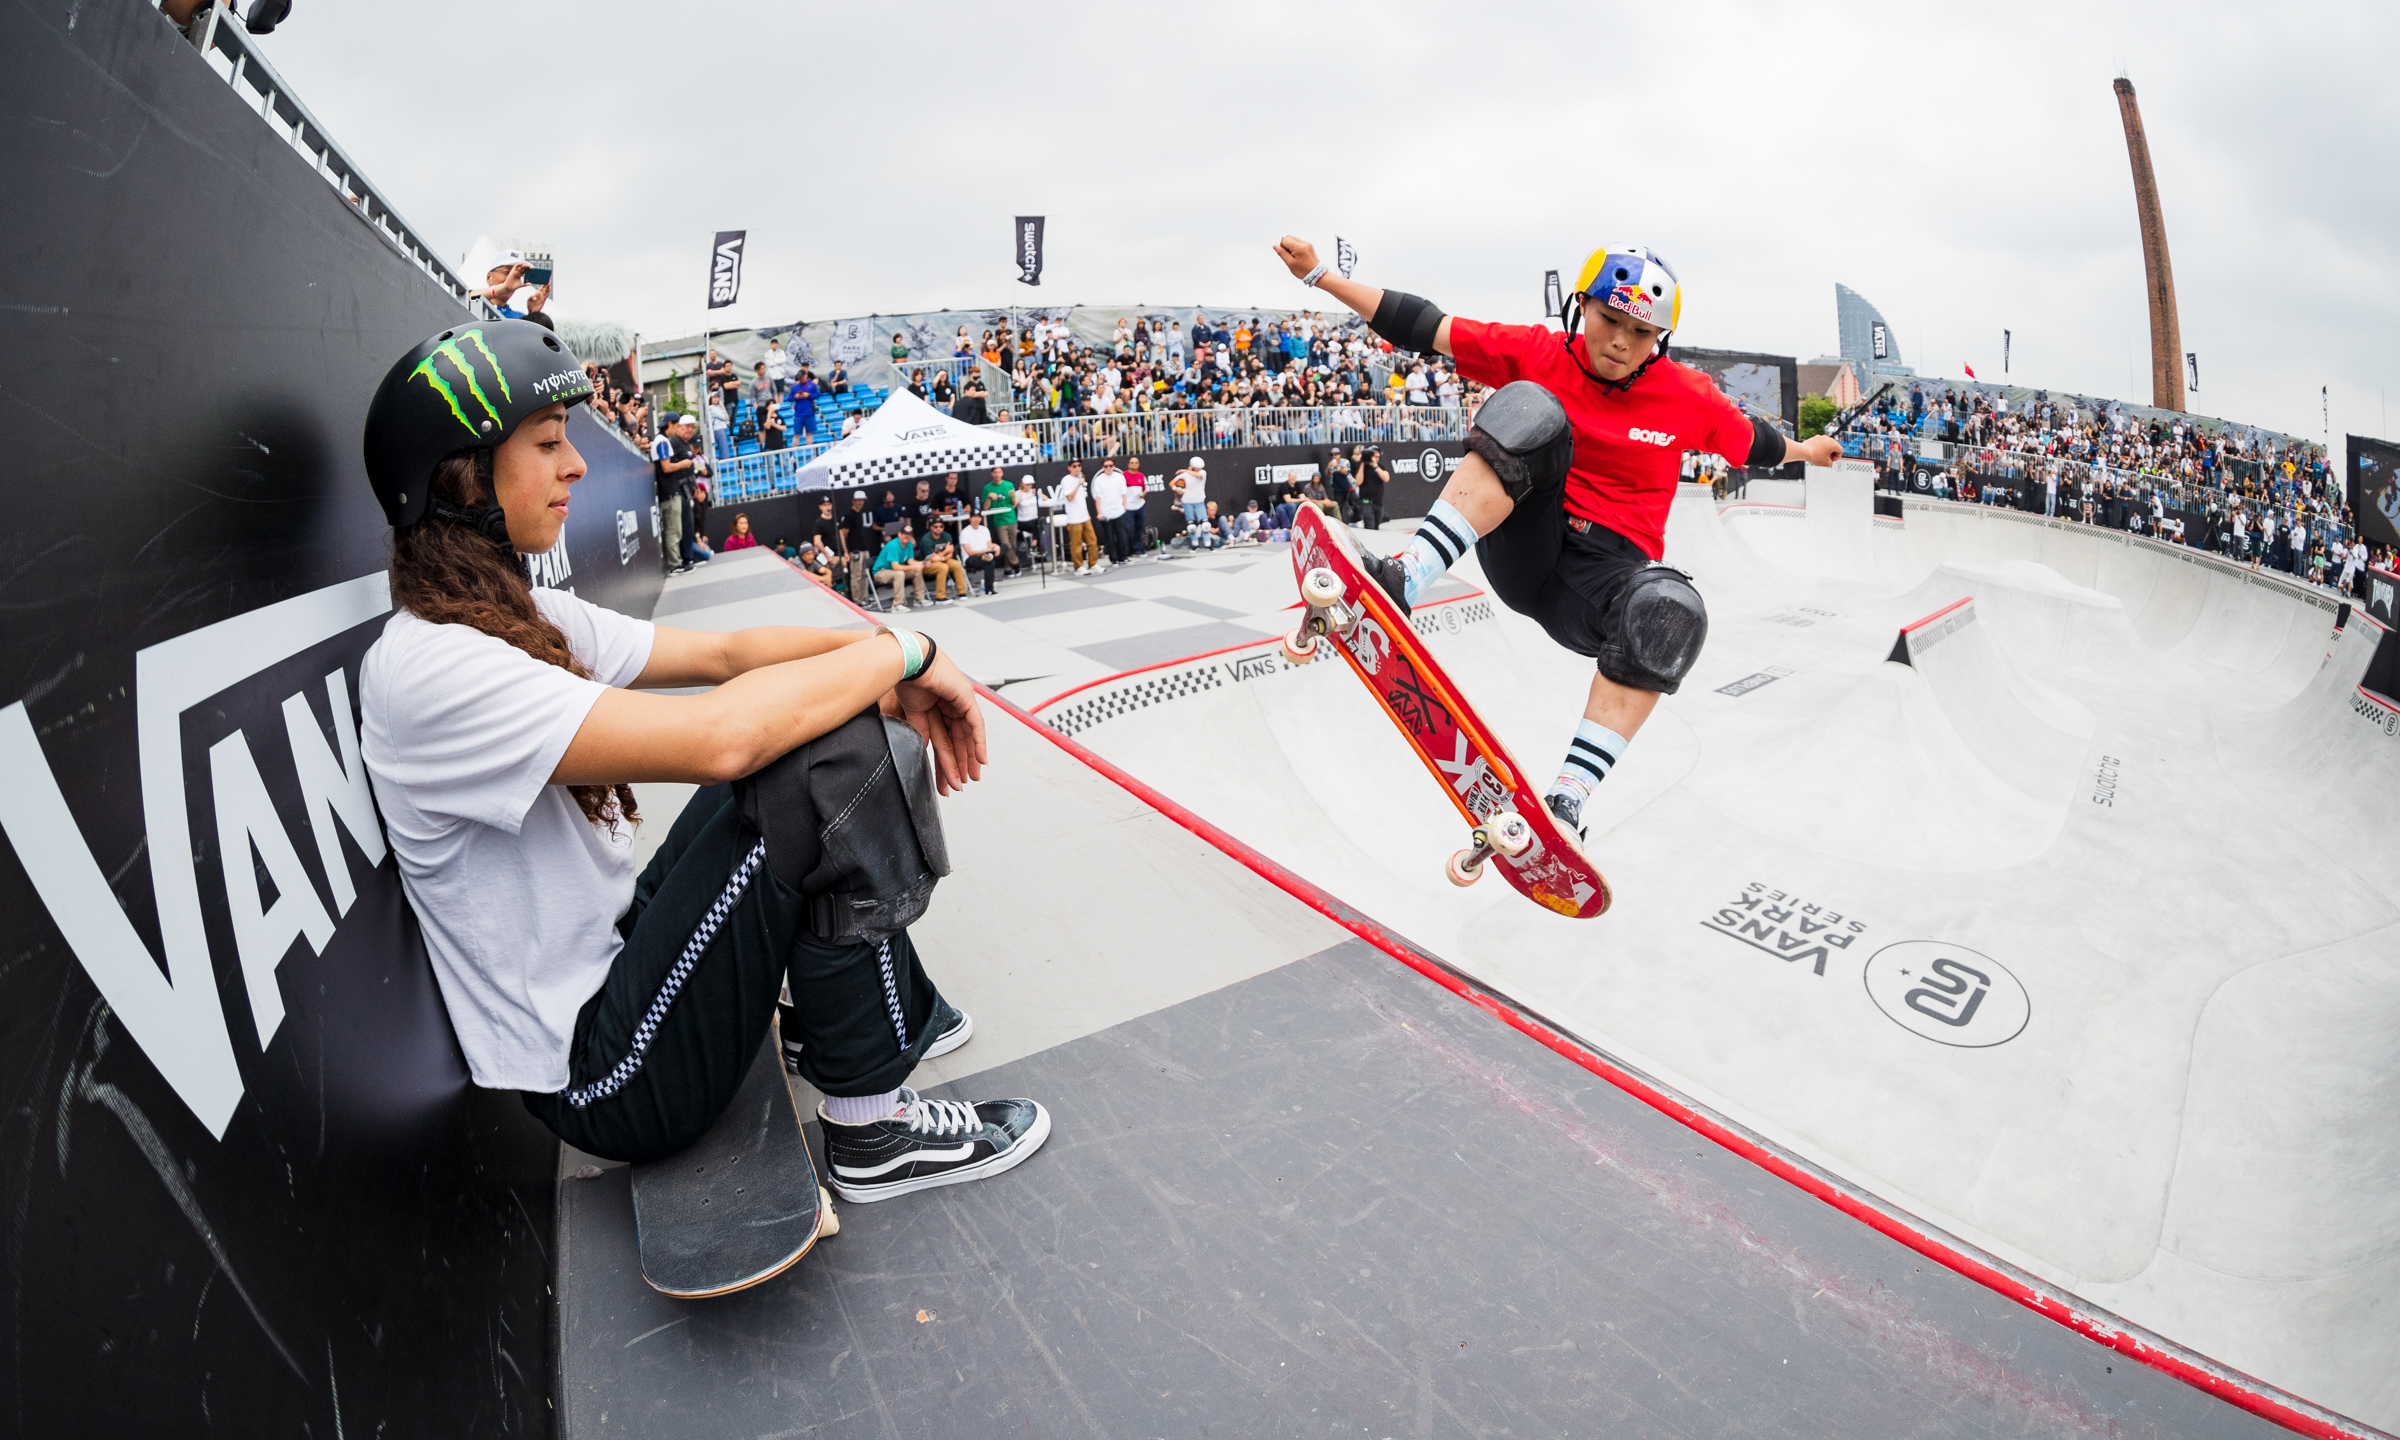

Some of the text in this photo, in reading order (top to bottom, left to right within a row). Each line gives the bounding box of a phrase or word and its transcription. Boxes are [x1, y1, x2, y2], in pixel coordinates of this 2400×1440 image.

[712, 238, 743, 303] VANS
[1608, 294, 1652, 321] Red Bull
[1873, 326, 1887, 357] VANS
[894, 424, 947, 441] VANS
[1628, 427, 1676, 447] BONES
[1391, 459, 1418, 474] VANS
[1444, 457, 1464, 465] PAR
[1145, 474, 1164, 484] ARK
[1224, 653, 1276, 682] VANS
[0, 570, 393, 1142] VAN
[1728, 891, 1856, 950] PARK
[1746, 882, 1868, 933] SERIES
[1699, 908, 1829, 977] VANS
